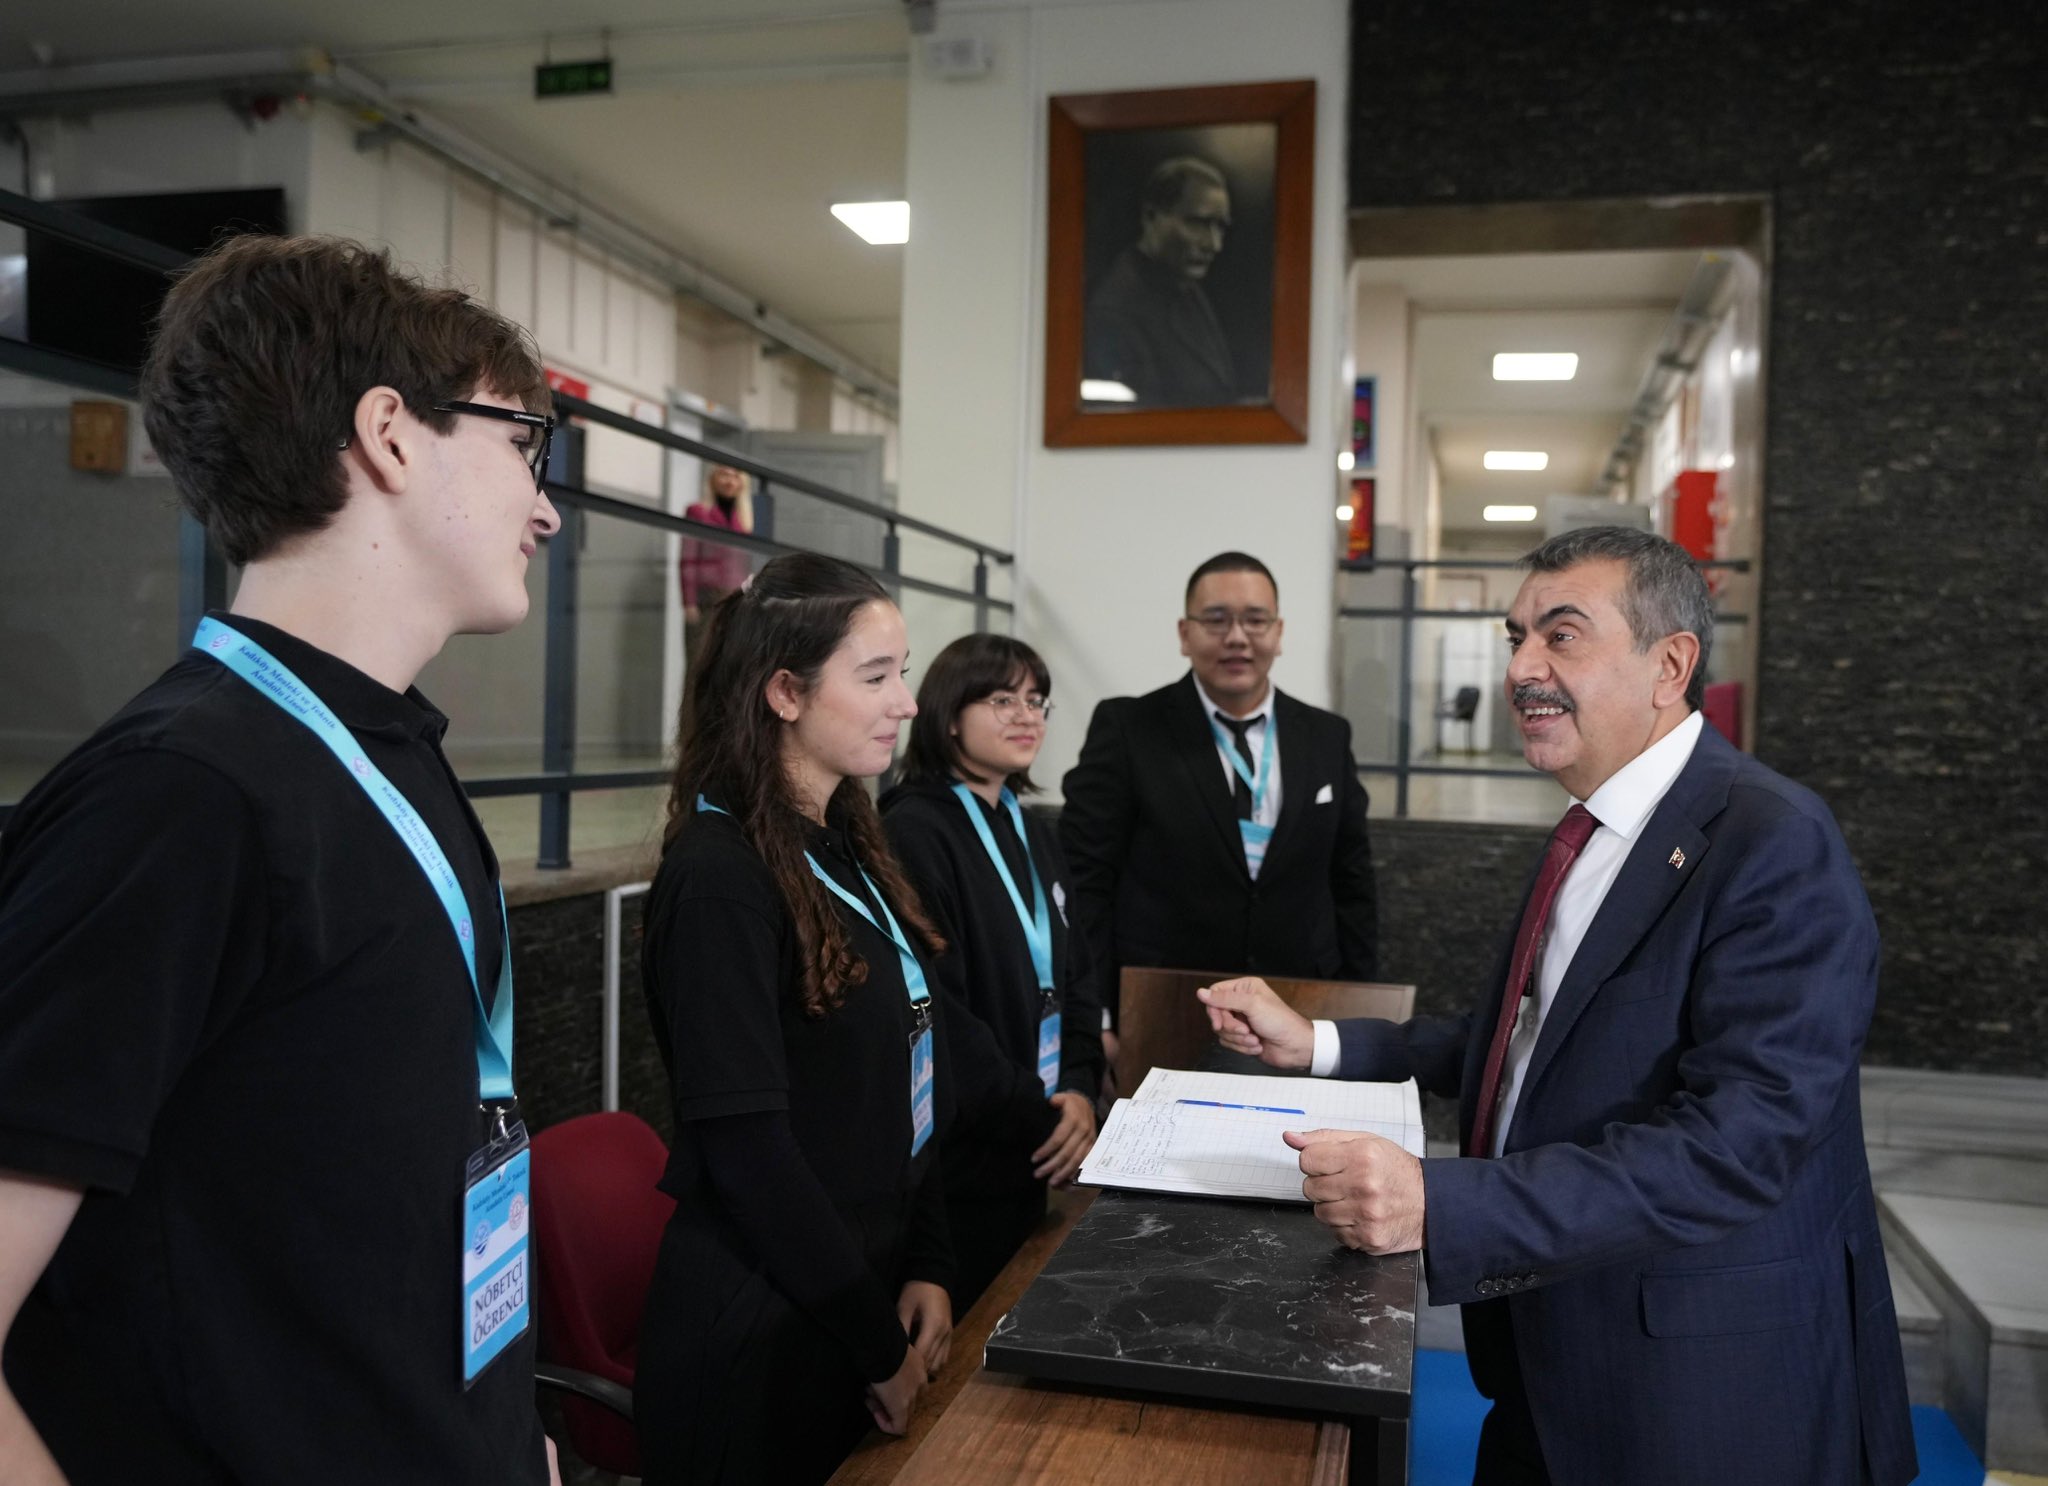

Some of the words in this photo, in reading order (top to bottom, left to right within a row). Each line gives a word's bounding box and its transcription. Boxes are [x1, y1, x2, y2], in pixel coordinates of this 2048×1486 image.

[251, 670, 285, 697] Anadolu
[284, 693, 308, 715] Lisesi
[311, 705, 336, 730] Teknik
[475, 1257, 522, 1316] NÖBETÇİ
[474, 1282, 524, 1344] ÖĞRENCİ
